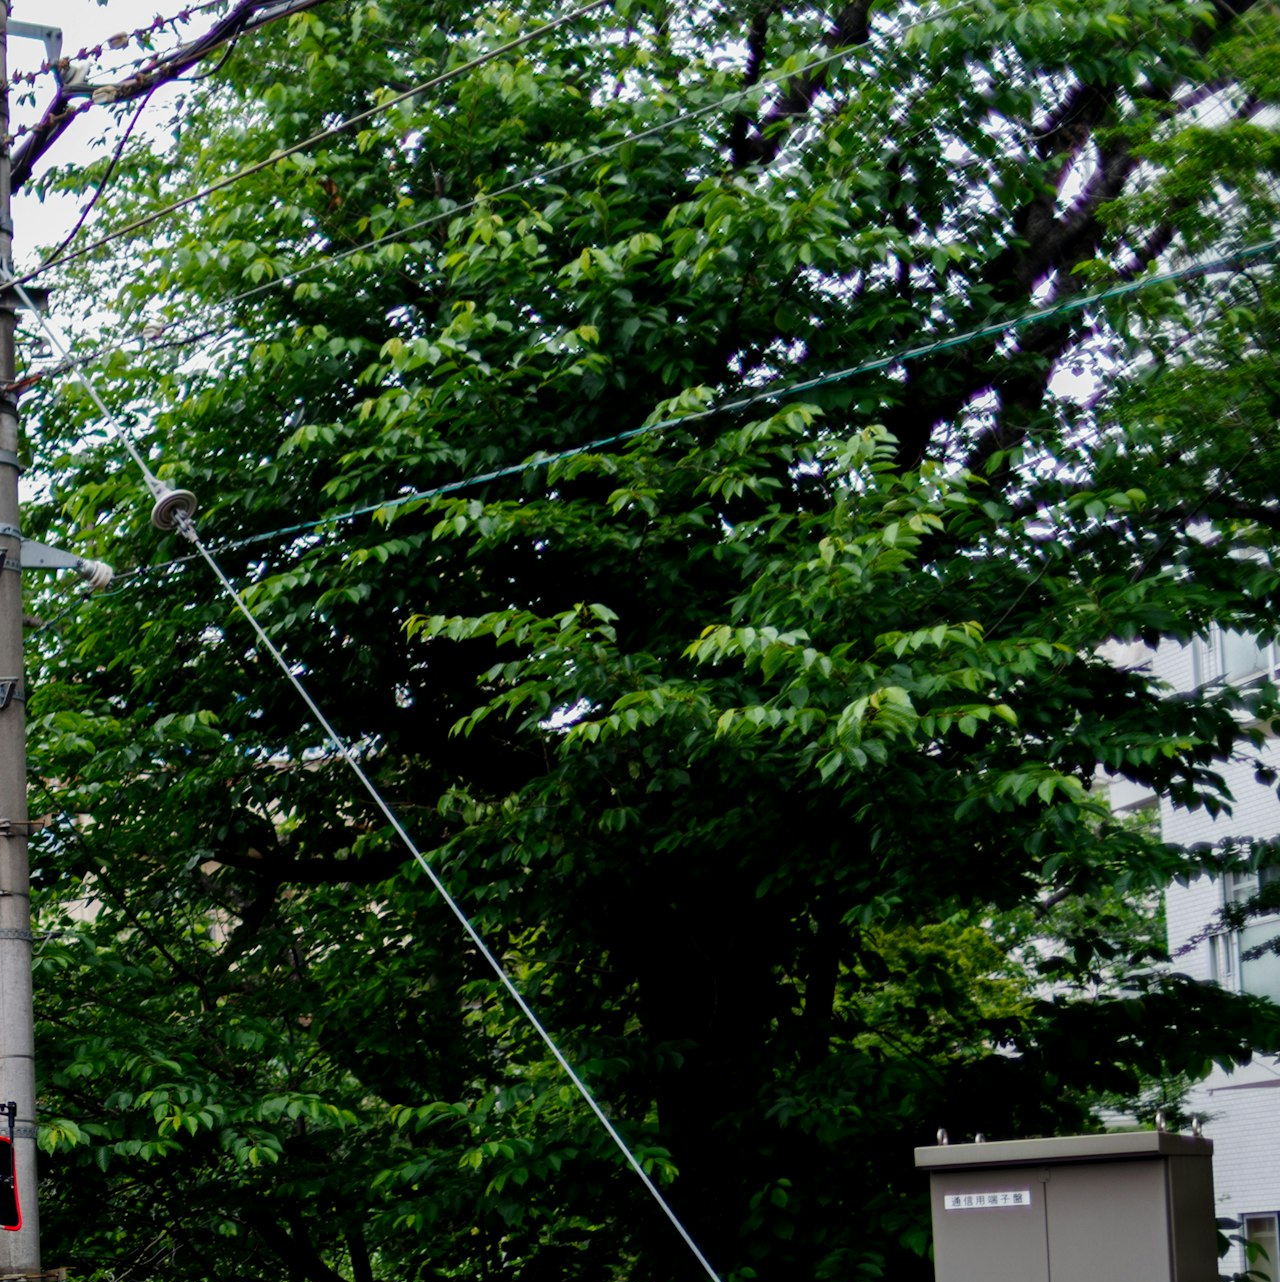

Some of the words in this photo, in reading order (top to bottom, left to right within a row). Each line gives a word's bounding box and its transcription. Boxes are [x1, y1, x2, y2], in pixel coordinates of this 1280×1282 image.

[951, 1193, 1023, 1207] 通信用端子盤
